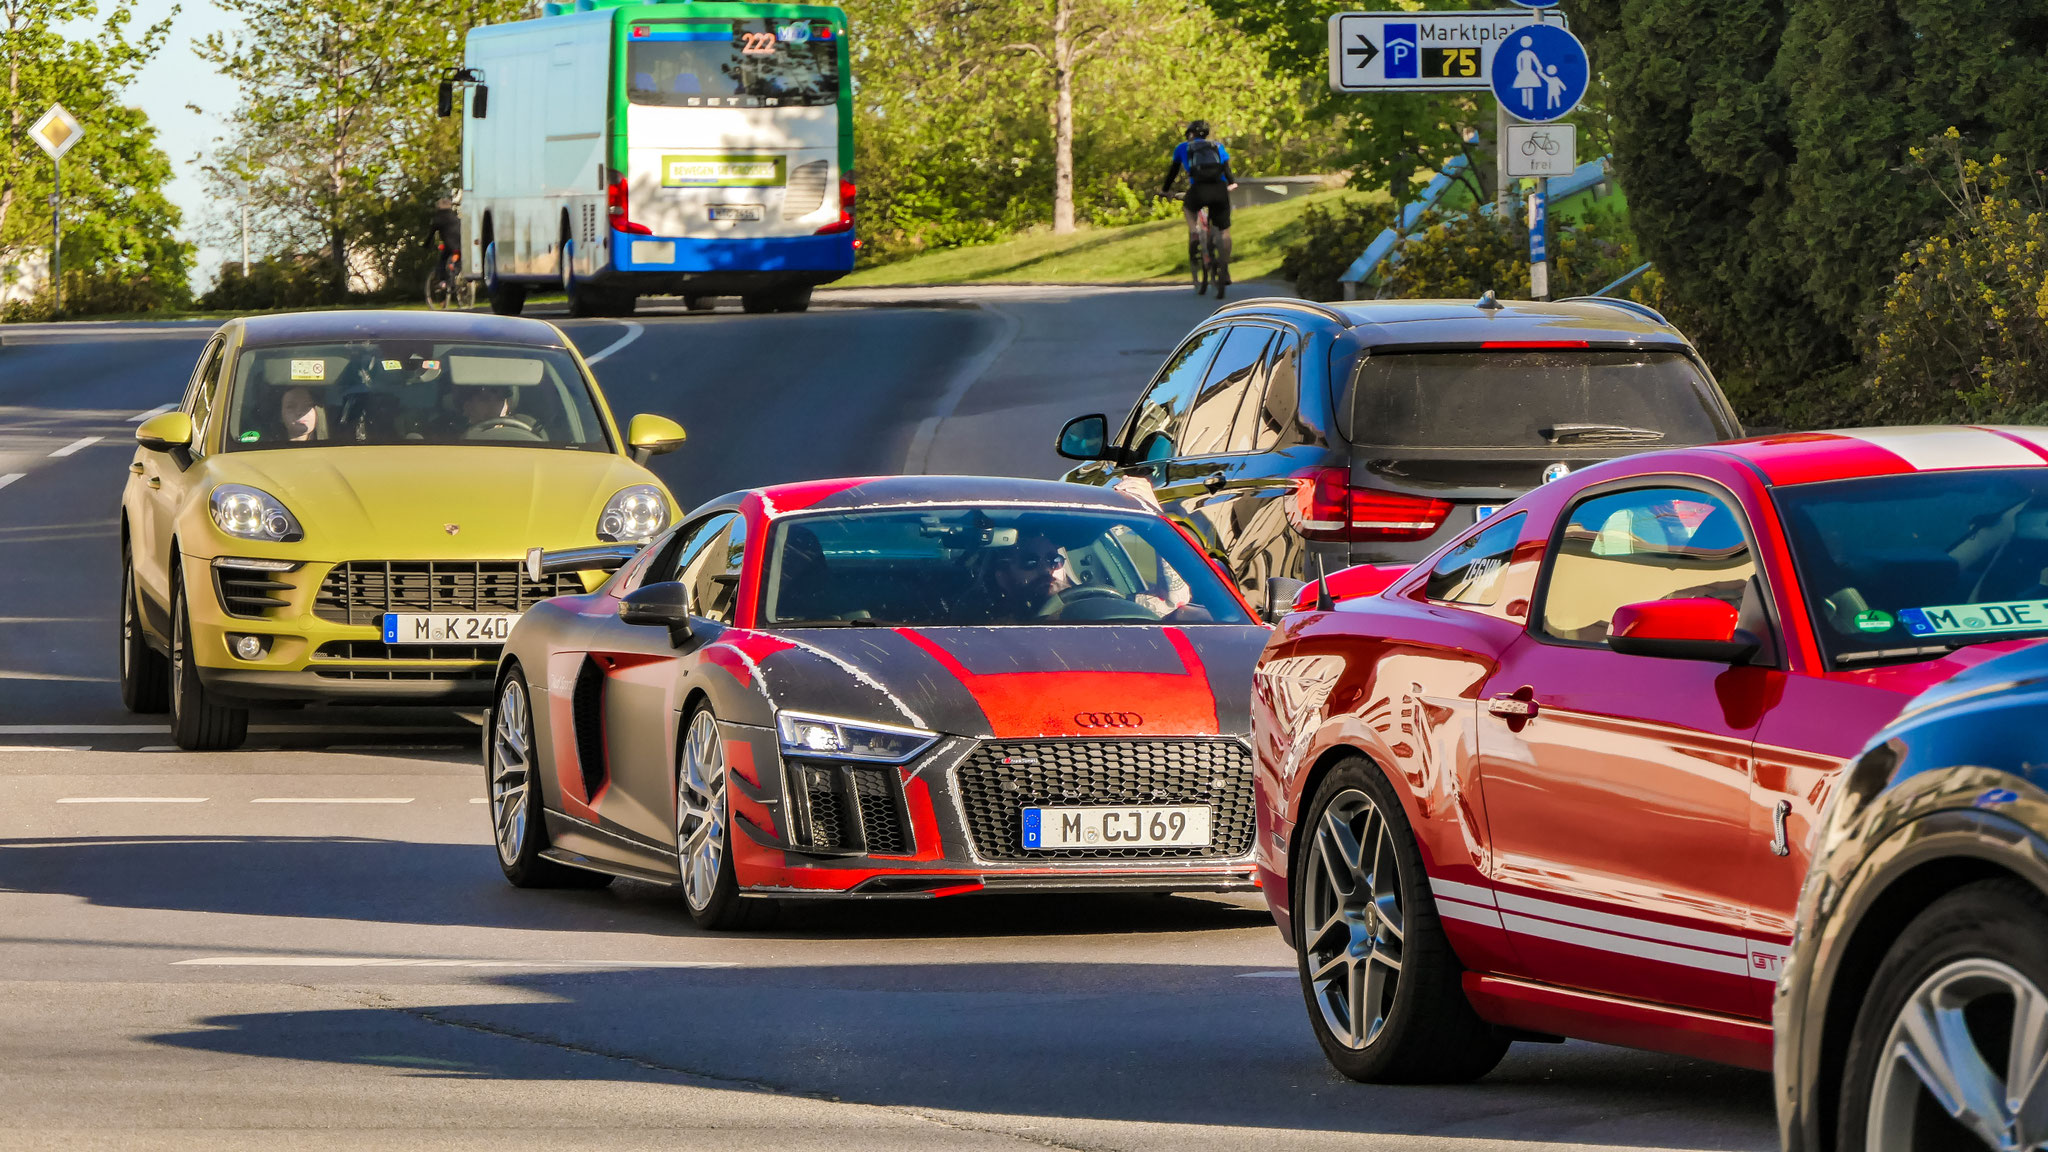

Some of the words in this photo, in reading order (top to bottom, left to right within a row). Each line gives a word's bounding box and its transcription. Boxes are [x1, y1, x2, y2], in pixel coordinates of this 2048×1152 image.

[742, 33, 776, 54] 222
[1394, 46, 1409, 65] P
[1442, 49, 1476, 76] 75
[1530, 158, 1552, 170] frei
[1867, 610, 1880, 622] 4
[1926, 609, 1961, 629] M
[1980, 604, 2043, 626] DE
[415, 617, 430, 640] M
[445, 617, 460, 640] K
[466, 617, 509, 640] 240
[1029, 832, 1037, 842] D
[1062, 813, 1081, 843] M
[1102, 812, 1142, 842] CJ
[1150, 811, 1186, 842] 69
